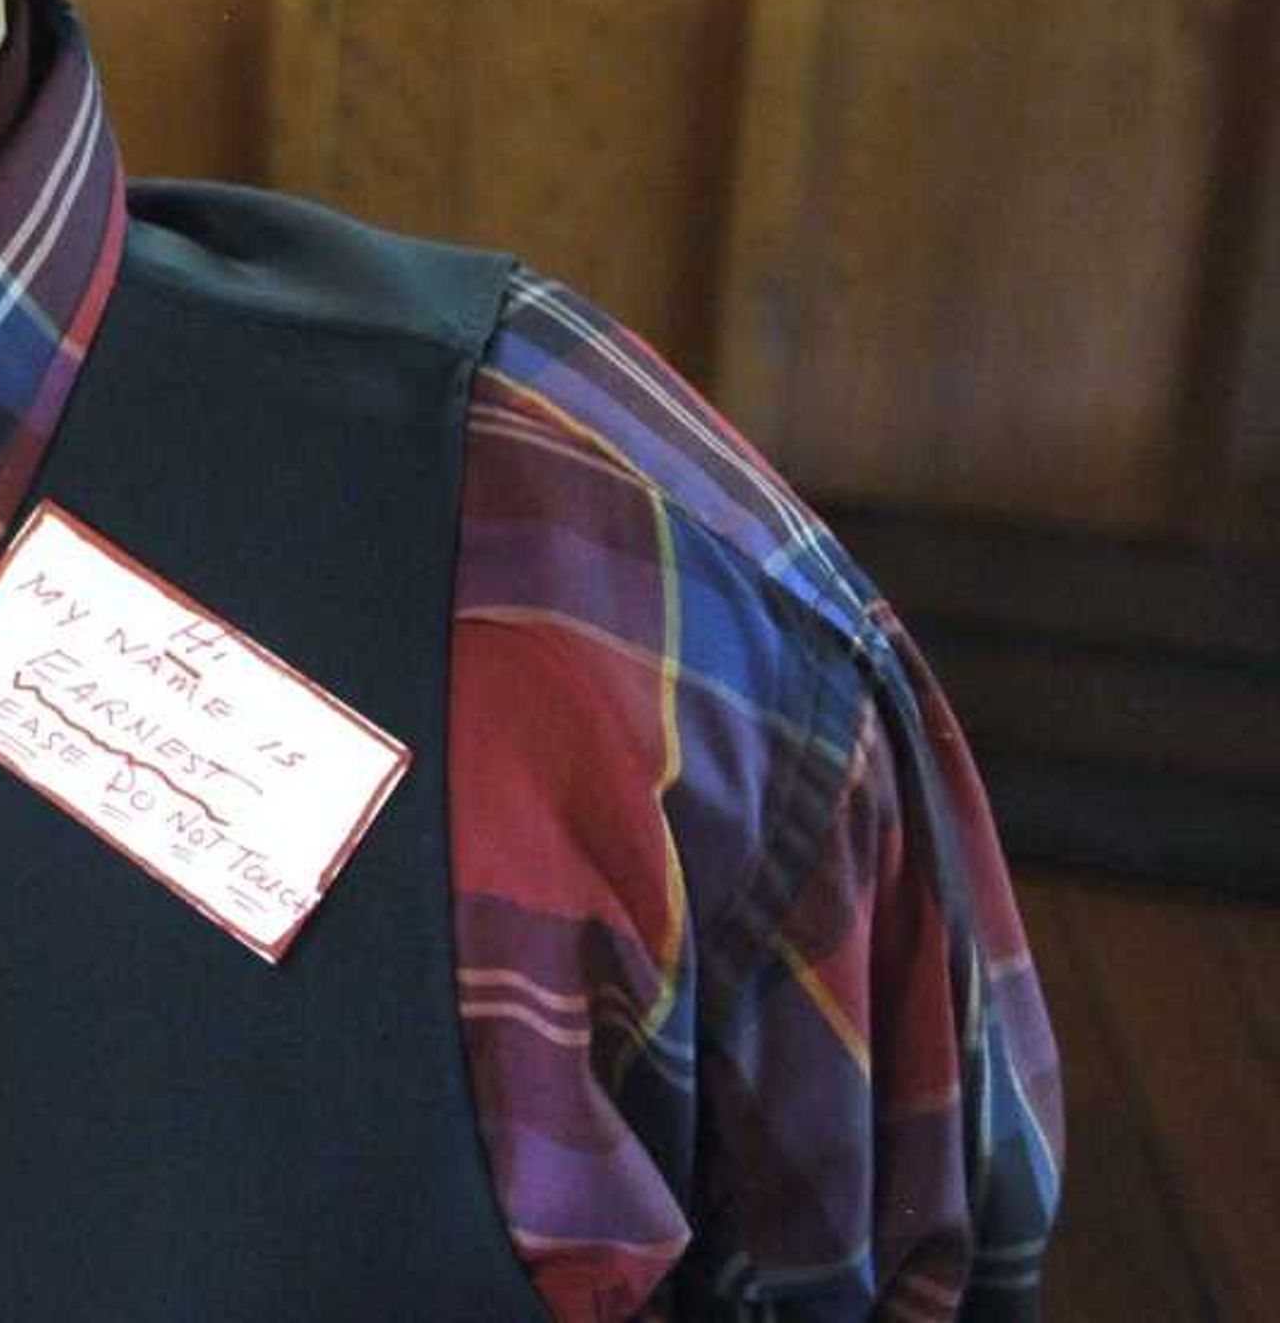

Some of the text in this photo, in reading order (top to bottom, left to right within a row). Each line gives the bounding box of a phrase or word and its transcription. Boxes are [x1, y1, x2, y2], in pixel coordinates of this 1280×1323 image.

[15, 571, 307, 768] MY NAME IS
[25, 648, 265, 796] EARNEST
[105, 767, 156, 812] DO
[165, 810, 237, 849] NOT
